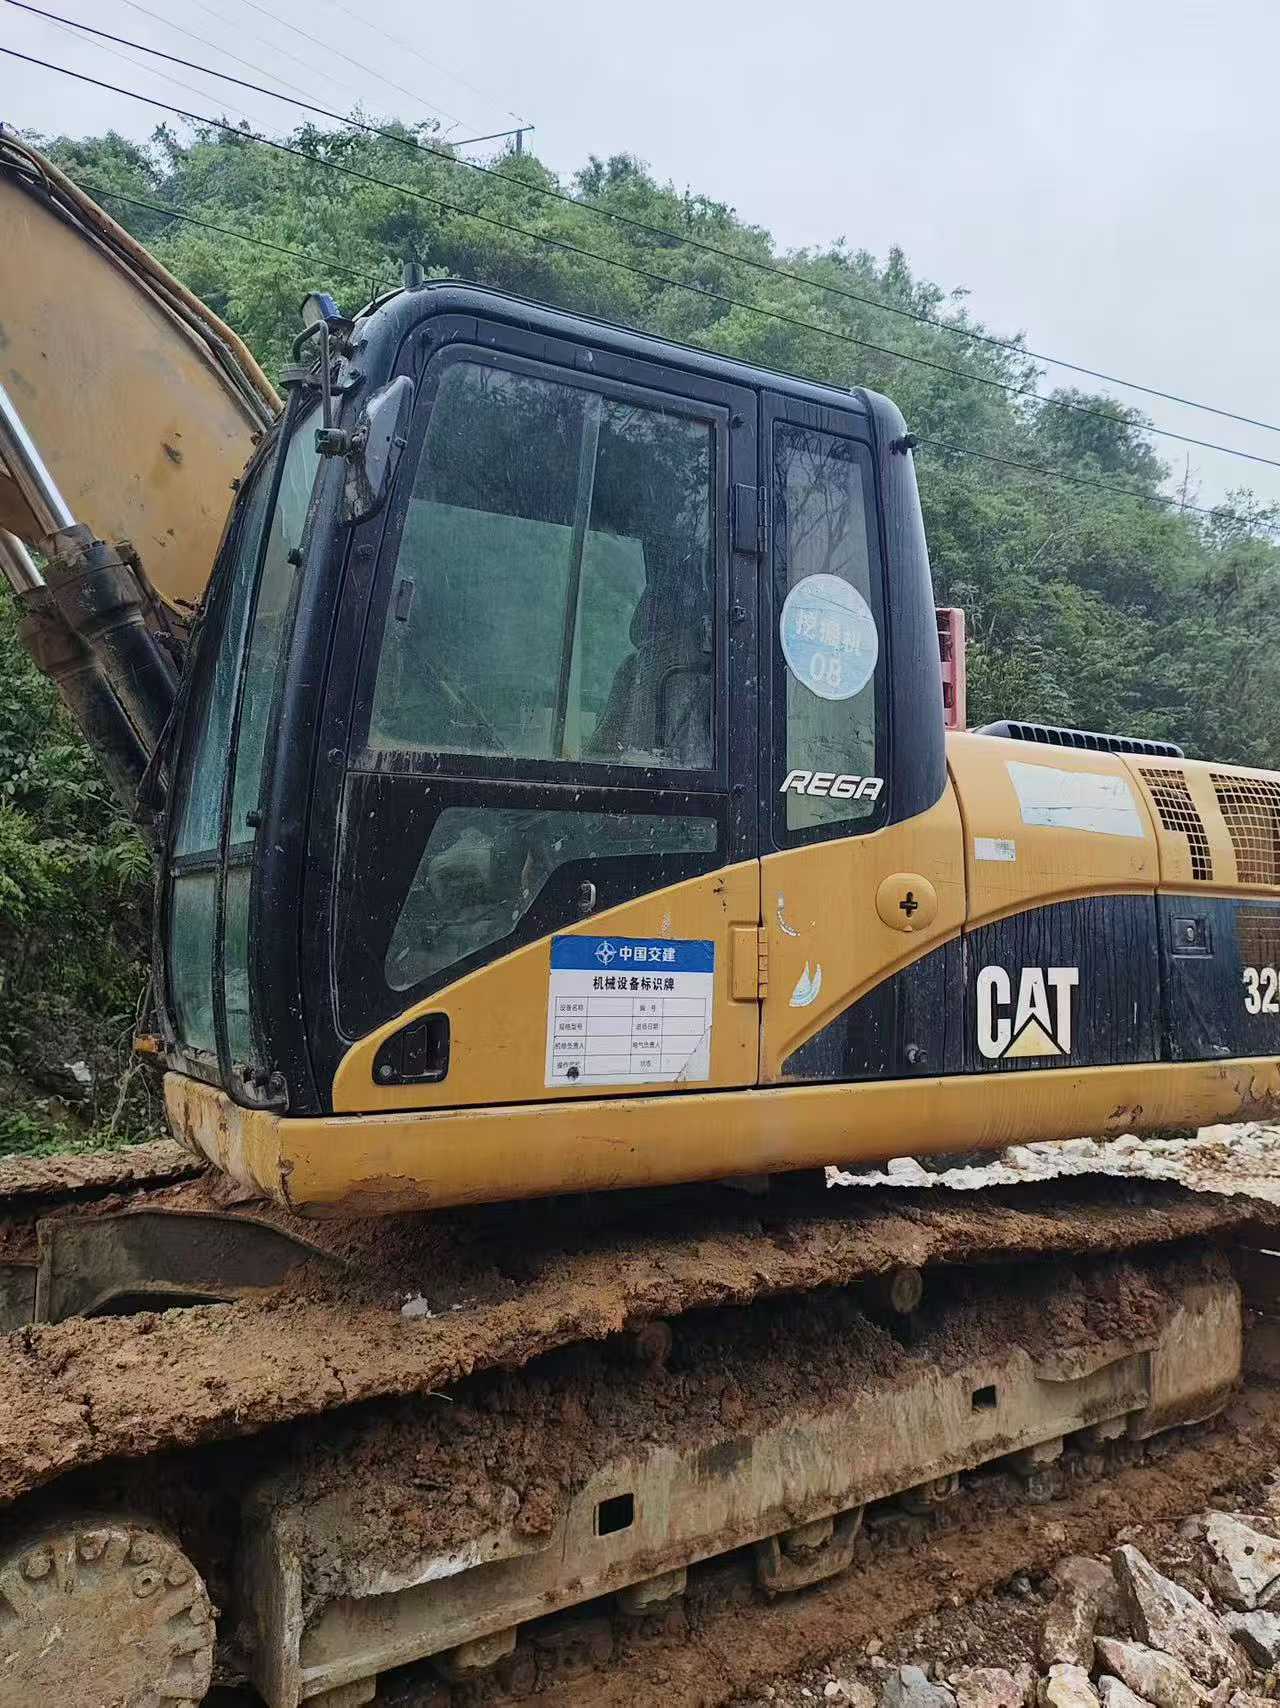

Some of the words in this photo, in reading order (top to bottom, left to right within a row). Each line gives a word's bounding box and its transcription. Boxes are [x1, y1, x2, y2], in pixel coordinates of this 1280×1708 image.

[809, 652, 843, 689] 08
[779, 769, 884, 801] REGA
[619, 945, 676, 962] 中国交建
[592, 975, 675, 992] 机械设备标识牌
[1242, 966, 1280, 1016] 32
[976, 965, 1079, 1059] CAT
